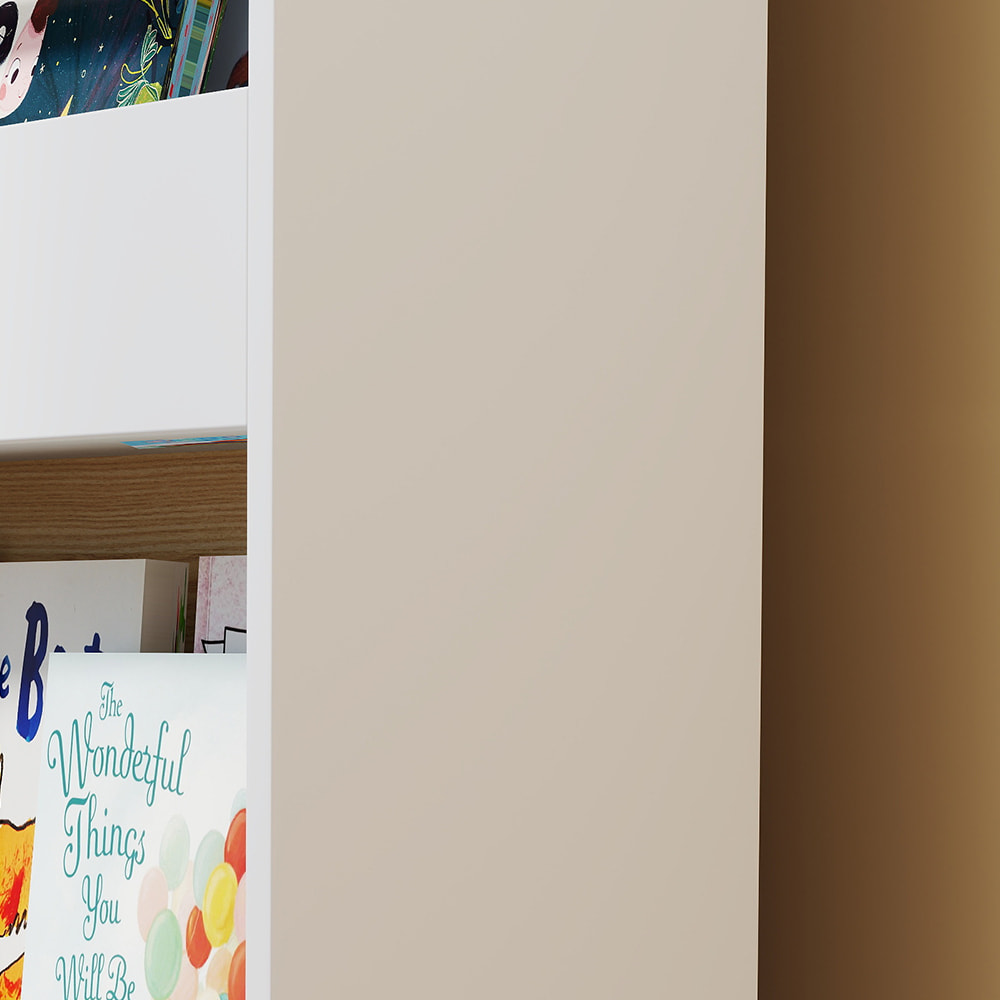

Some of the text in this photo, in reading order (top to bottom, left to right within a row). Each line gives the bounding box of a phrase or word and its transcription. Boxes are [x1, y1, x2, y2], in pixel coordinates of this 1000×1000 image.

[99, 681, 123, 721] The
[47, 711, 192, 807] Wonderful
[63, 792, 145, 880] Things
[81, 873, 121, 941] You
